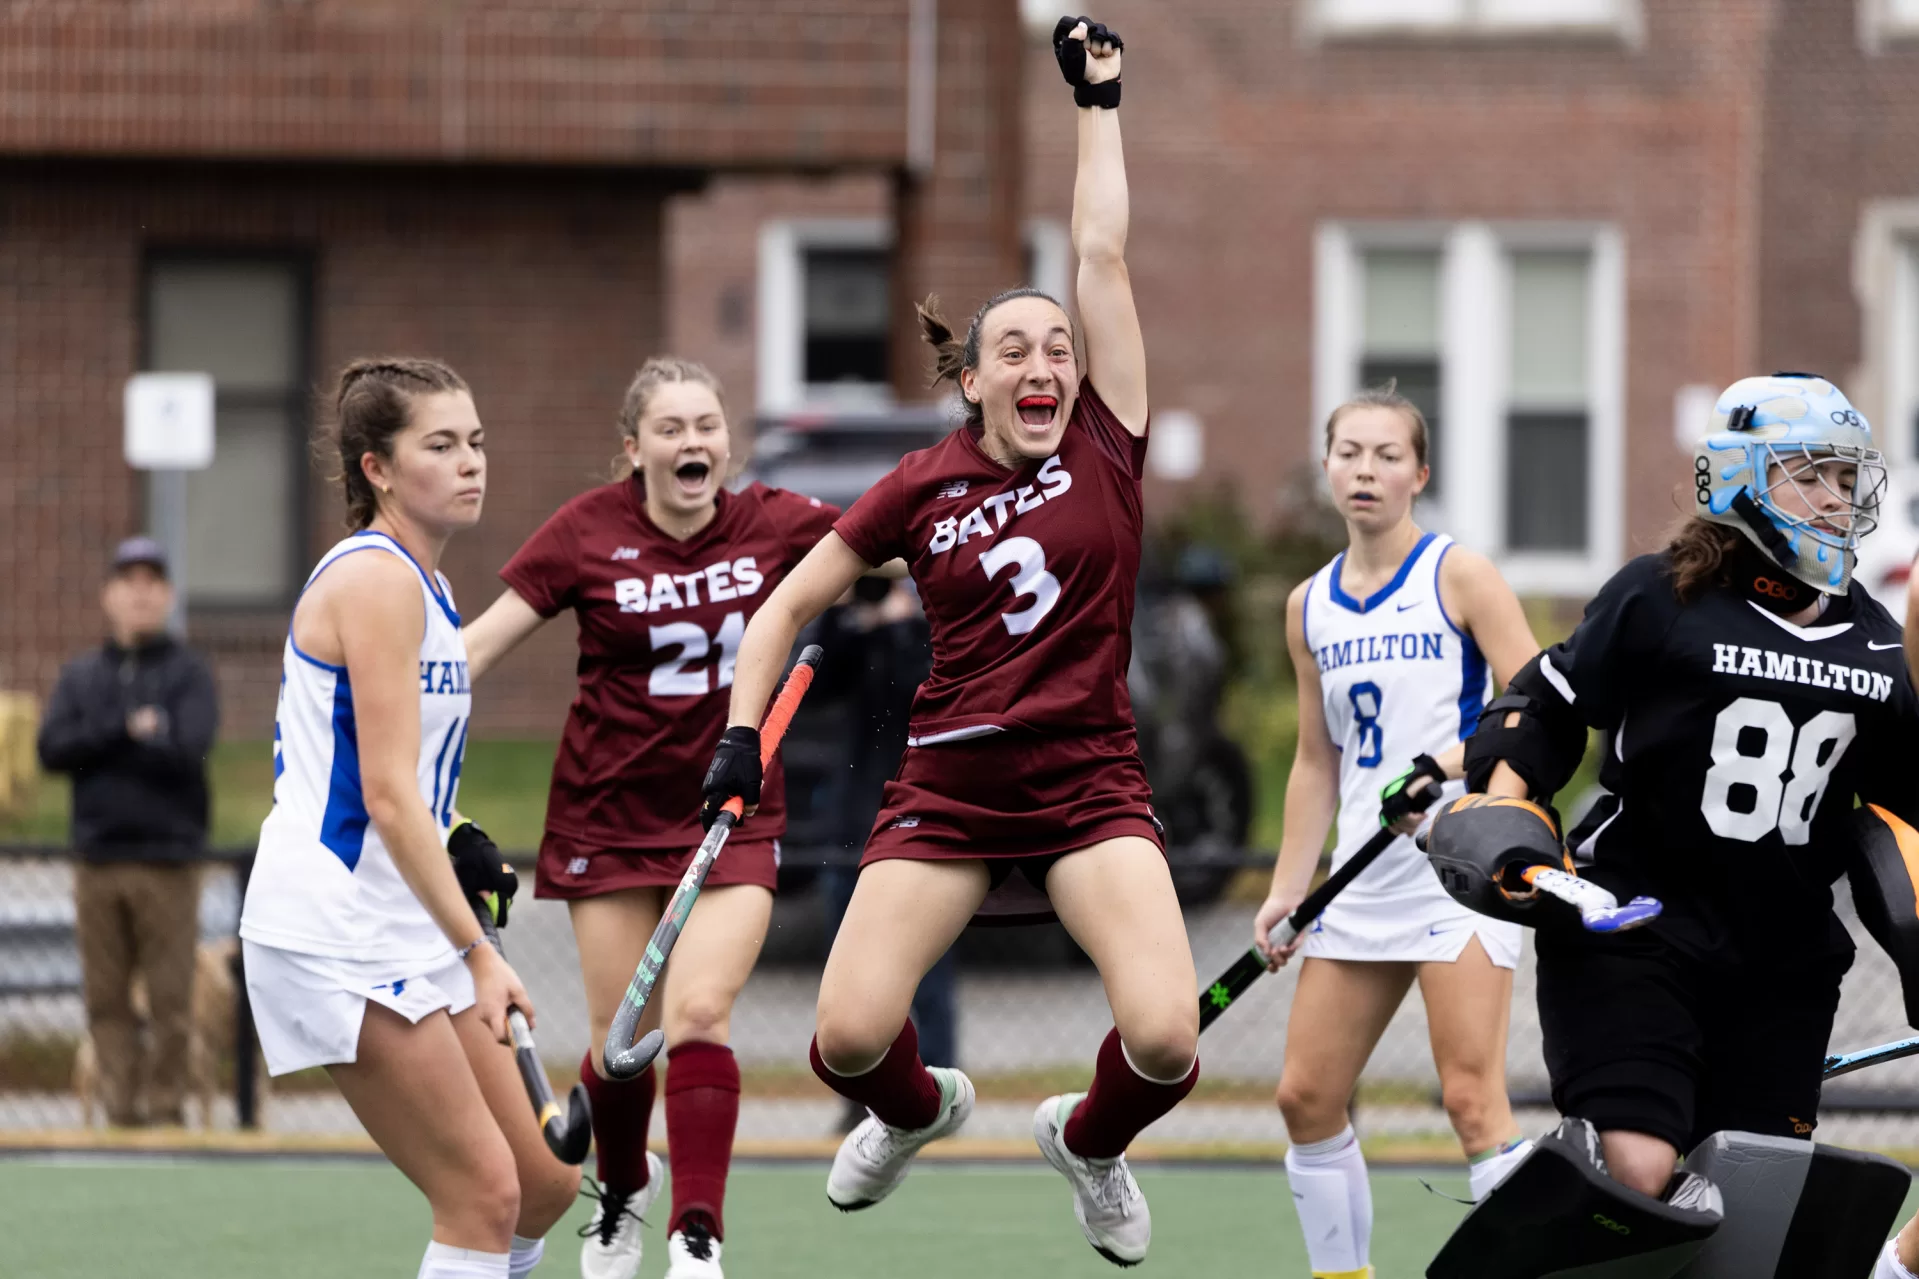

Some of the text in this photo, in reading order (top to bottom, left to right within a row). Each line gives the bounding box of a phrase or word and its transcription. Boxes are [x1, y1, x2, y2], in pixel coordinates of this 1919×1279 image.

[928, 454, 1073, 555] BATES
[1695, 456, 1711, 505] OBO
[614, 556, 765, 613] BATES
[979, 536, 1062, 636] 3
[1753, 577, 1798, 600] OBO
[648, 610, 747, 697] 21
[1712, 643, 1894, 703] HAMILTON
[1348, 680, 1383, 768] 8
[1700, 696, 1858, 846] 88
